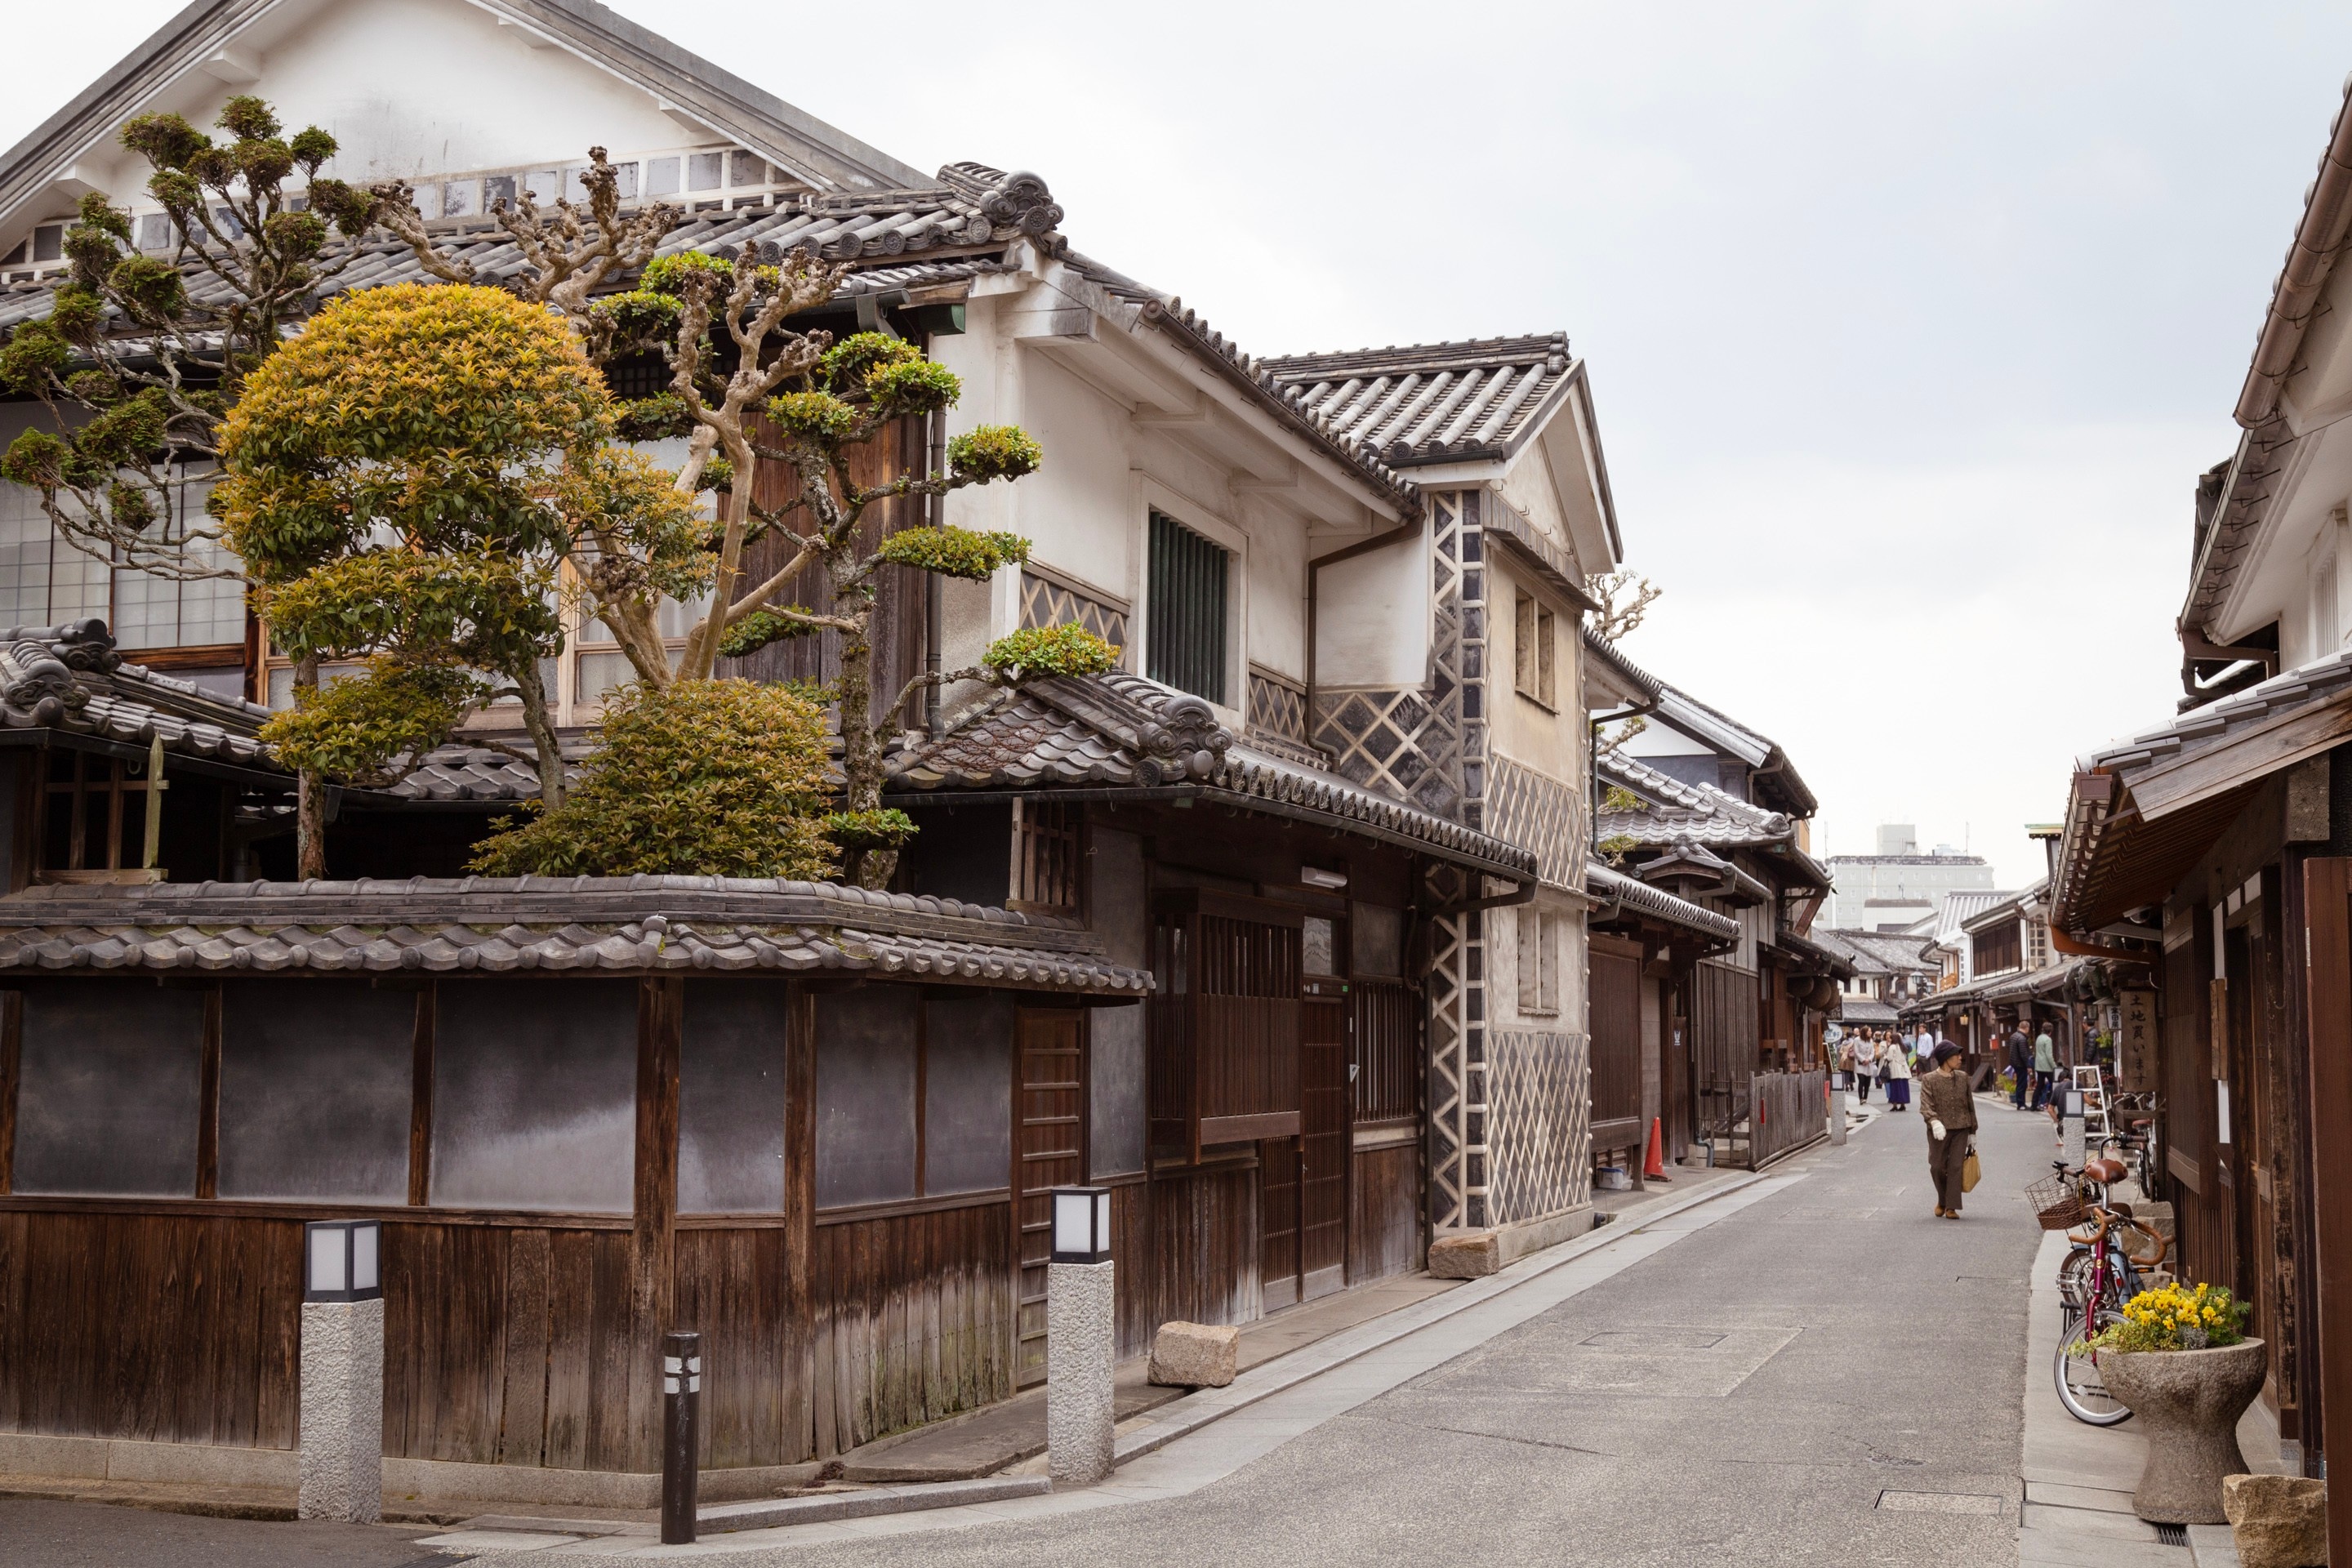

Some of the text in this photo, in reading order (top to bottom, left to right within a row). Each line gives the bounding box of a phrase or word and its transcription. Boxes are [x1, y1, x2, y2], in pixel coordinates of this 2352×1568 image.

[2130, 994, 2146, 1086] 土地買います
